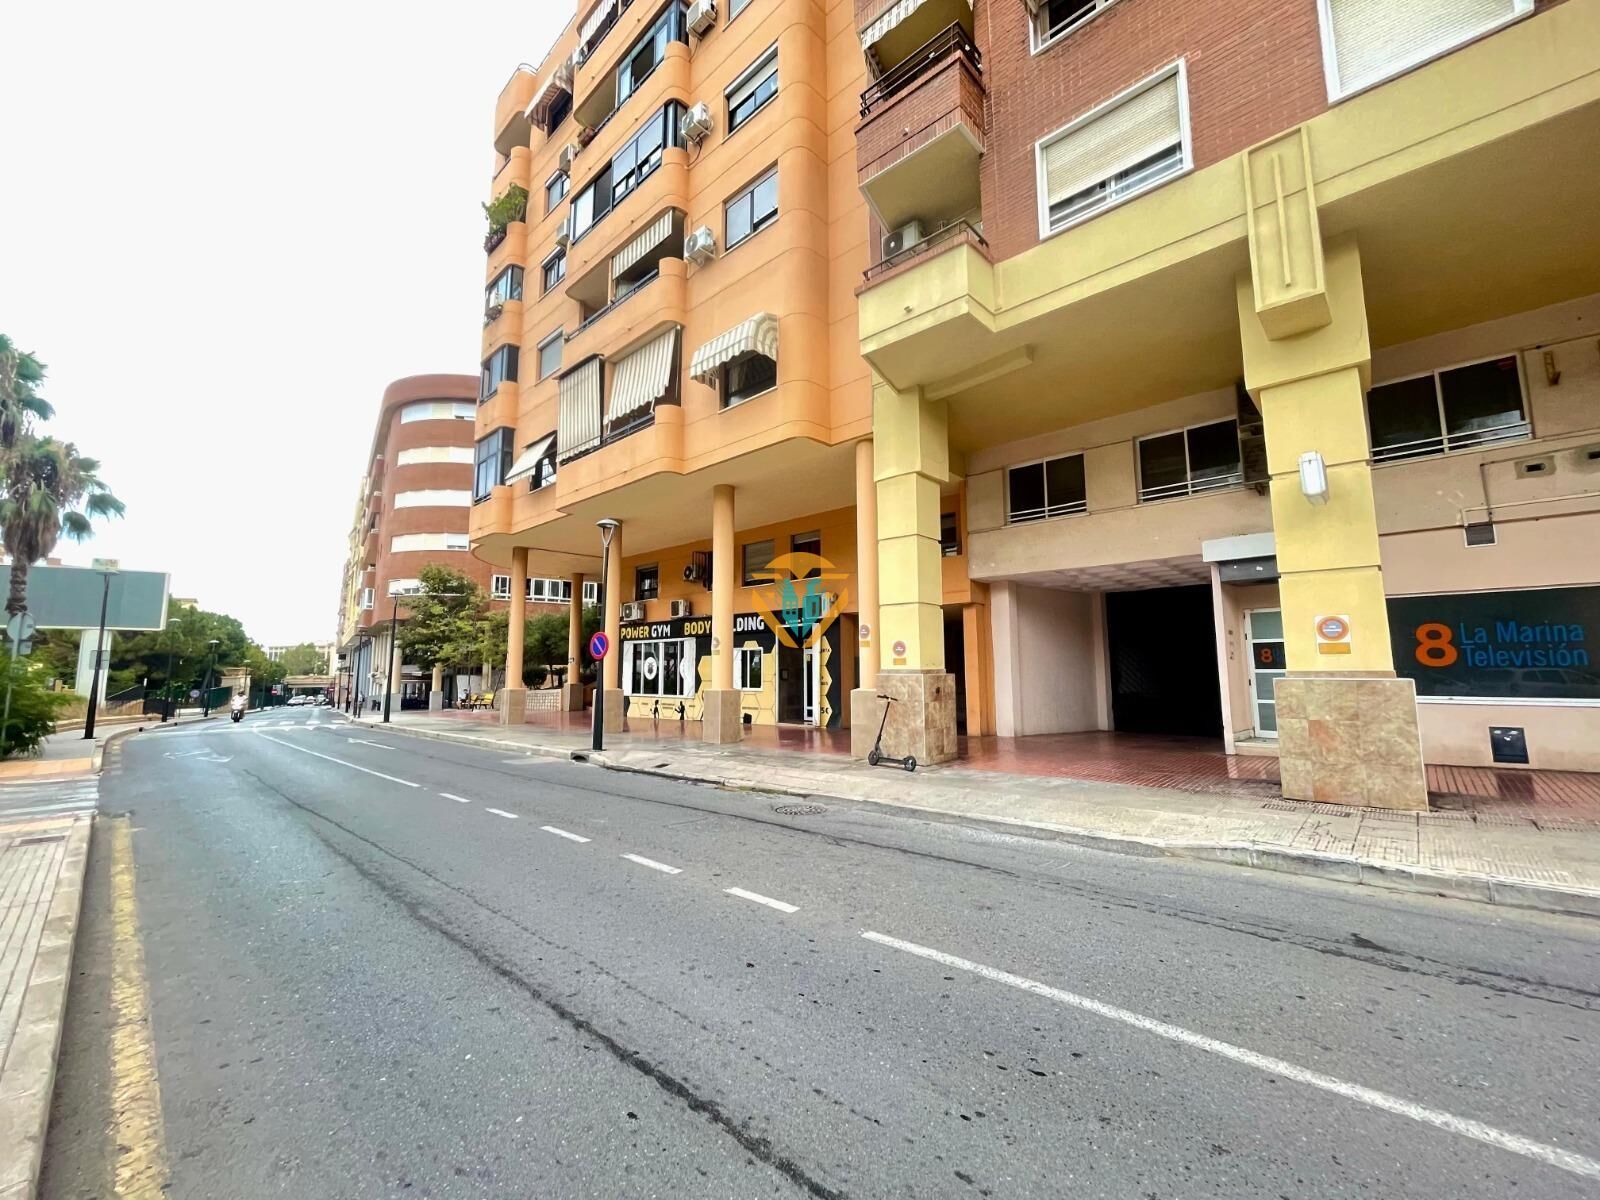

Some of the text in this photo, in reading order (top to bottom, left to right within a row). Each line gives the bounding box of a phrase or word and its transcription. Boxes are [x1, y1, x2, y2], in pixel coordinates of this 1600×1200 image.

[620, 625, 649, 639] POWER
[651, 624, 671, 637] GYM
[1460, 620, 1585, 644] La Marina
[1260, 648, 1273, 663] 8
[1415, 623, 1458, 667] 8
[1461, 643, 1589, 667] Televisión
